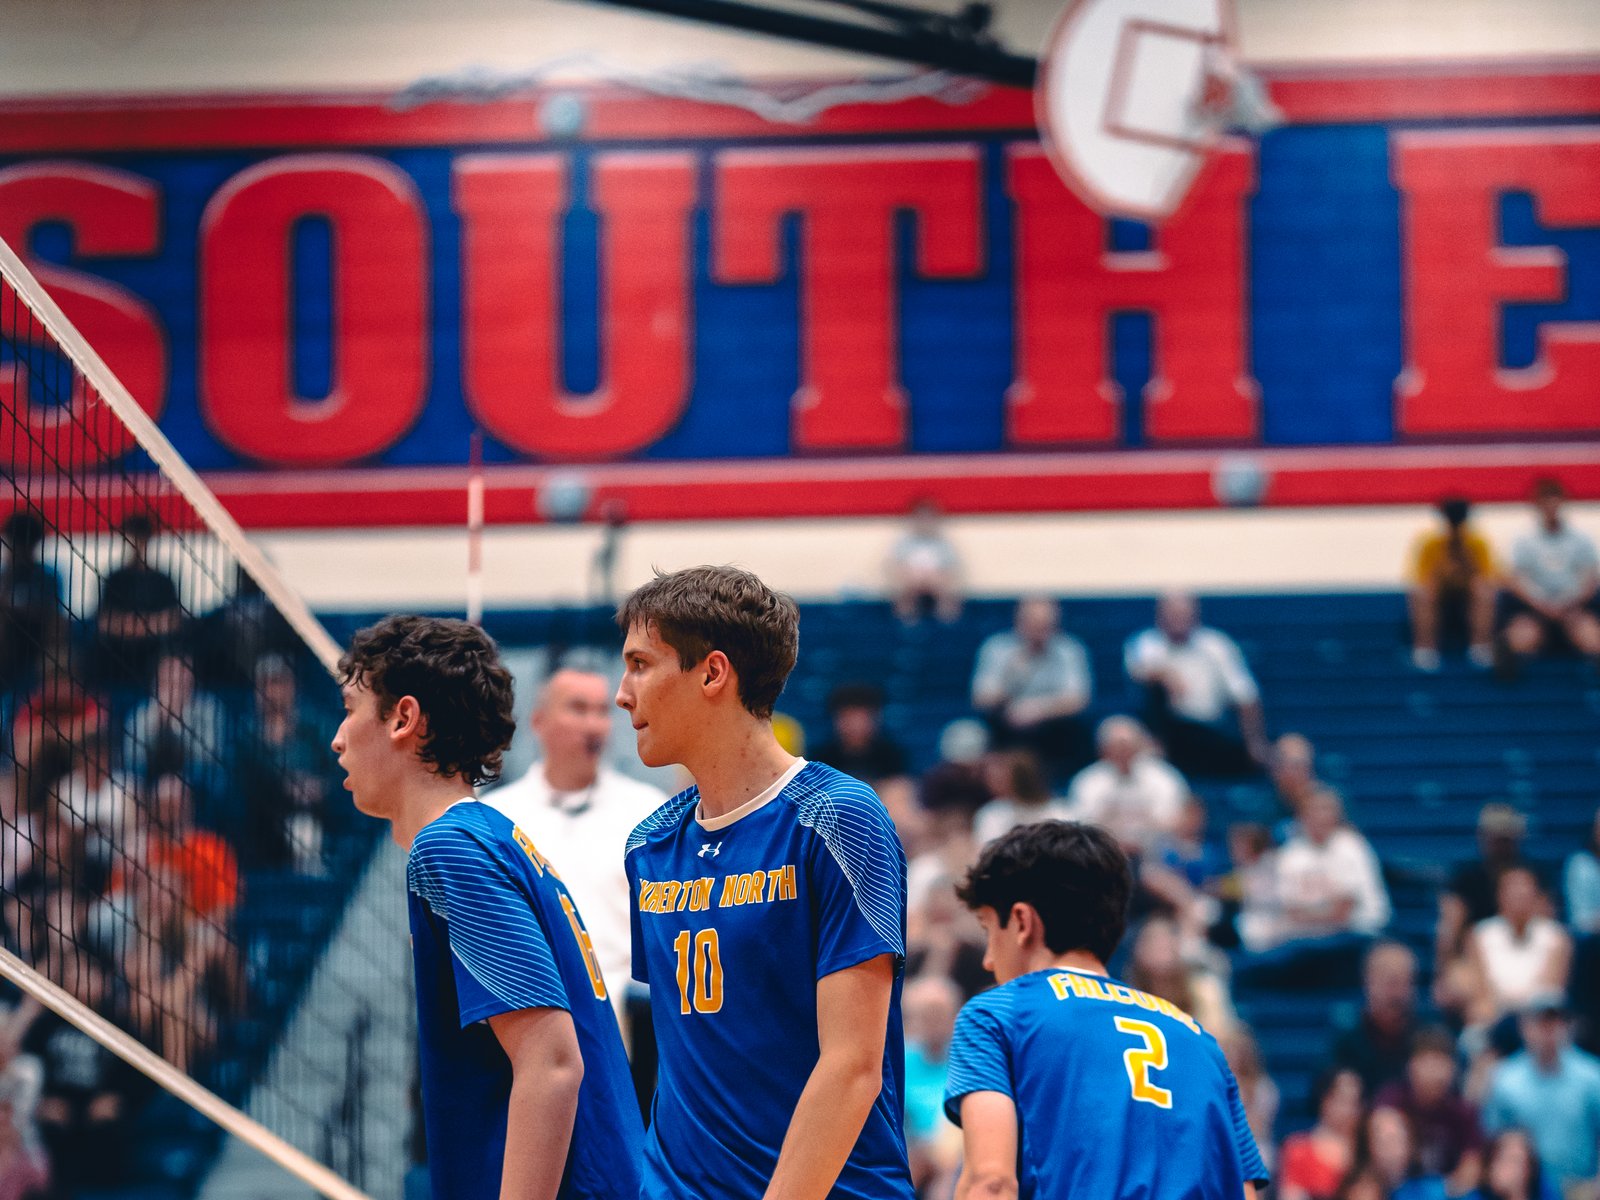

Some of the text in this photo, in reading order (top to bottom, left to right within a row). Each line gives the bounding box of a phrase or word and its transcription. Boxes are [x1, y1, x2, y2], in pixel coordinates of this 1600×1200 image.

[0, 140, 1260, 469] SOUTH
[718, 864, 797, 908] NORTH
[674, 927, 724, 1015] 10
[1113, 1015, 1173, 1109] 2
